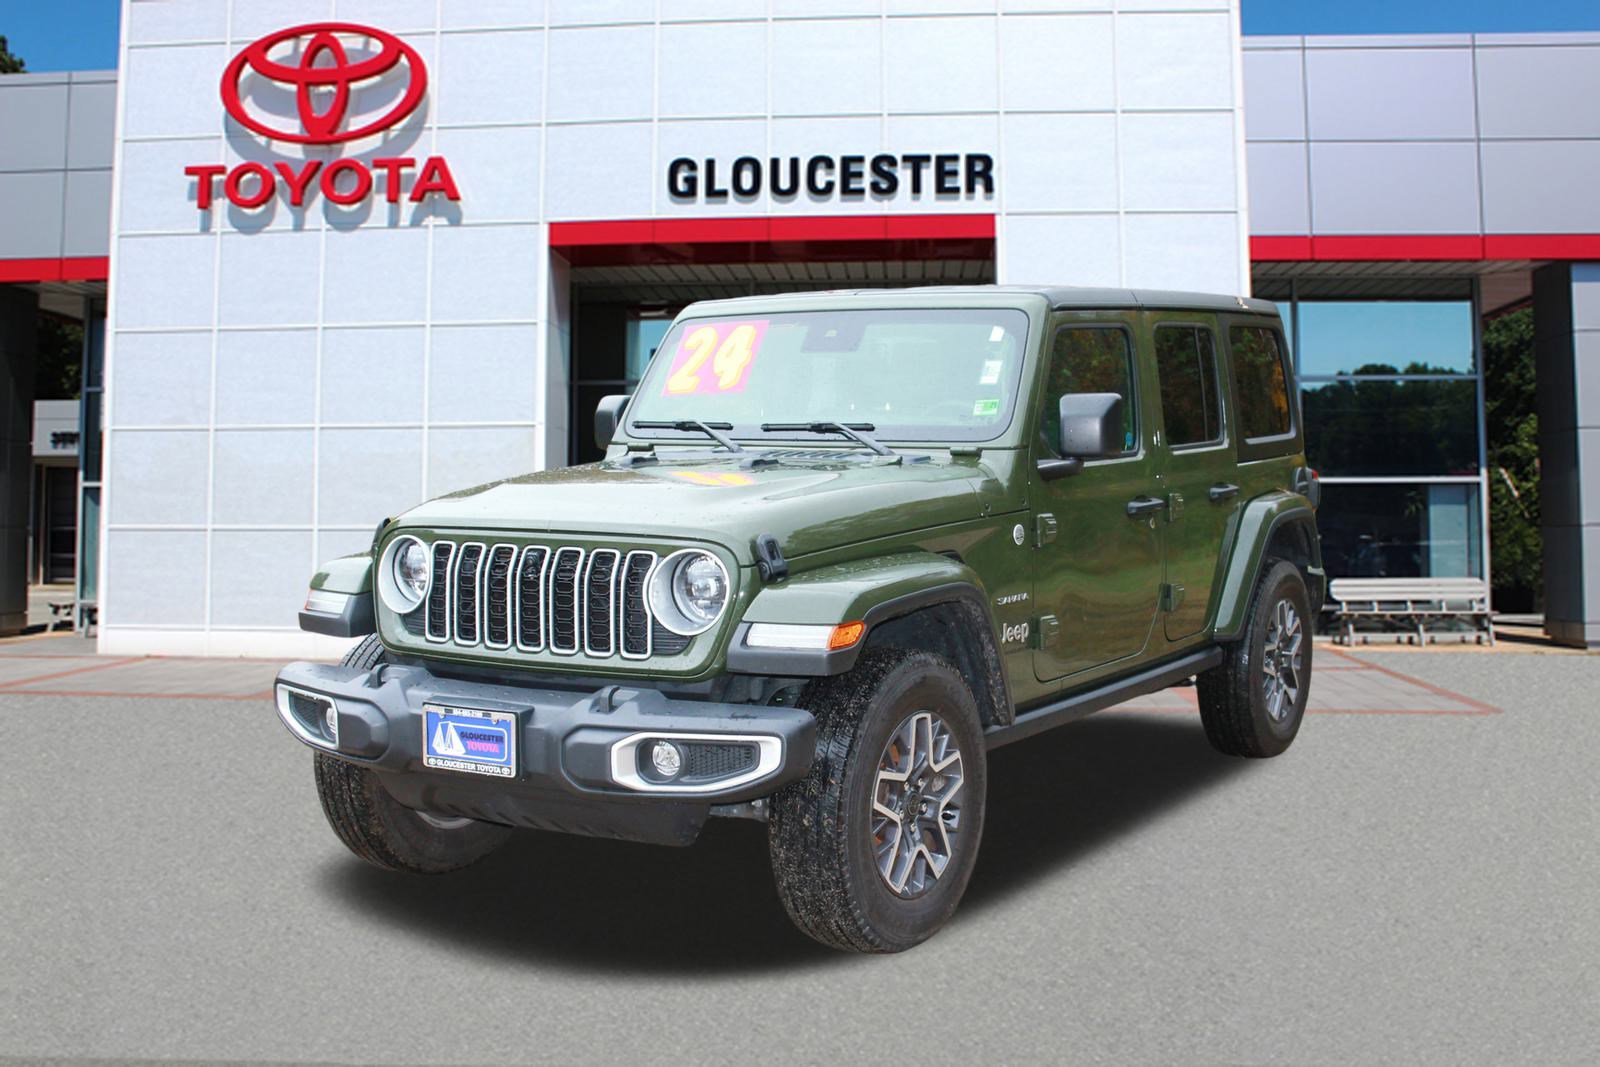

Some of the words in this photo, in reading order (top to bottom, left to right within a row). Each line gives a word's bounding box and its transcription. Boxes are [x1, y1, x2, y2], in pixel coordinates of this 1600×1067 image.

[184, 156, 461, 210] TOYOTA
[668, 154, 994, 198] GLOUCESTER
[667, 325, 756, 394] 24
[1001, 622, 1029, 644] Jeep
[460, 731, 504, 743] GLOUCESTER
[466, 740, 500, 753] TOYOTA
[437, 759, 476, 770] GLOUCESTER
[476, 764, 501, 774] TOYOTA
